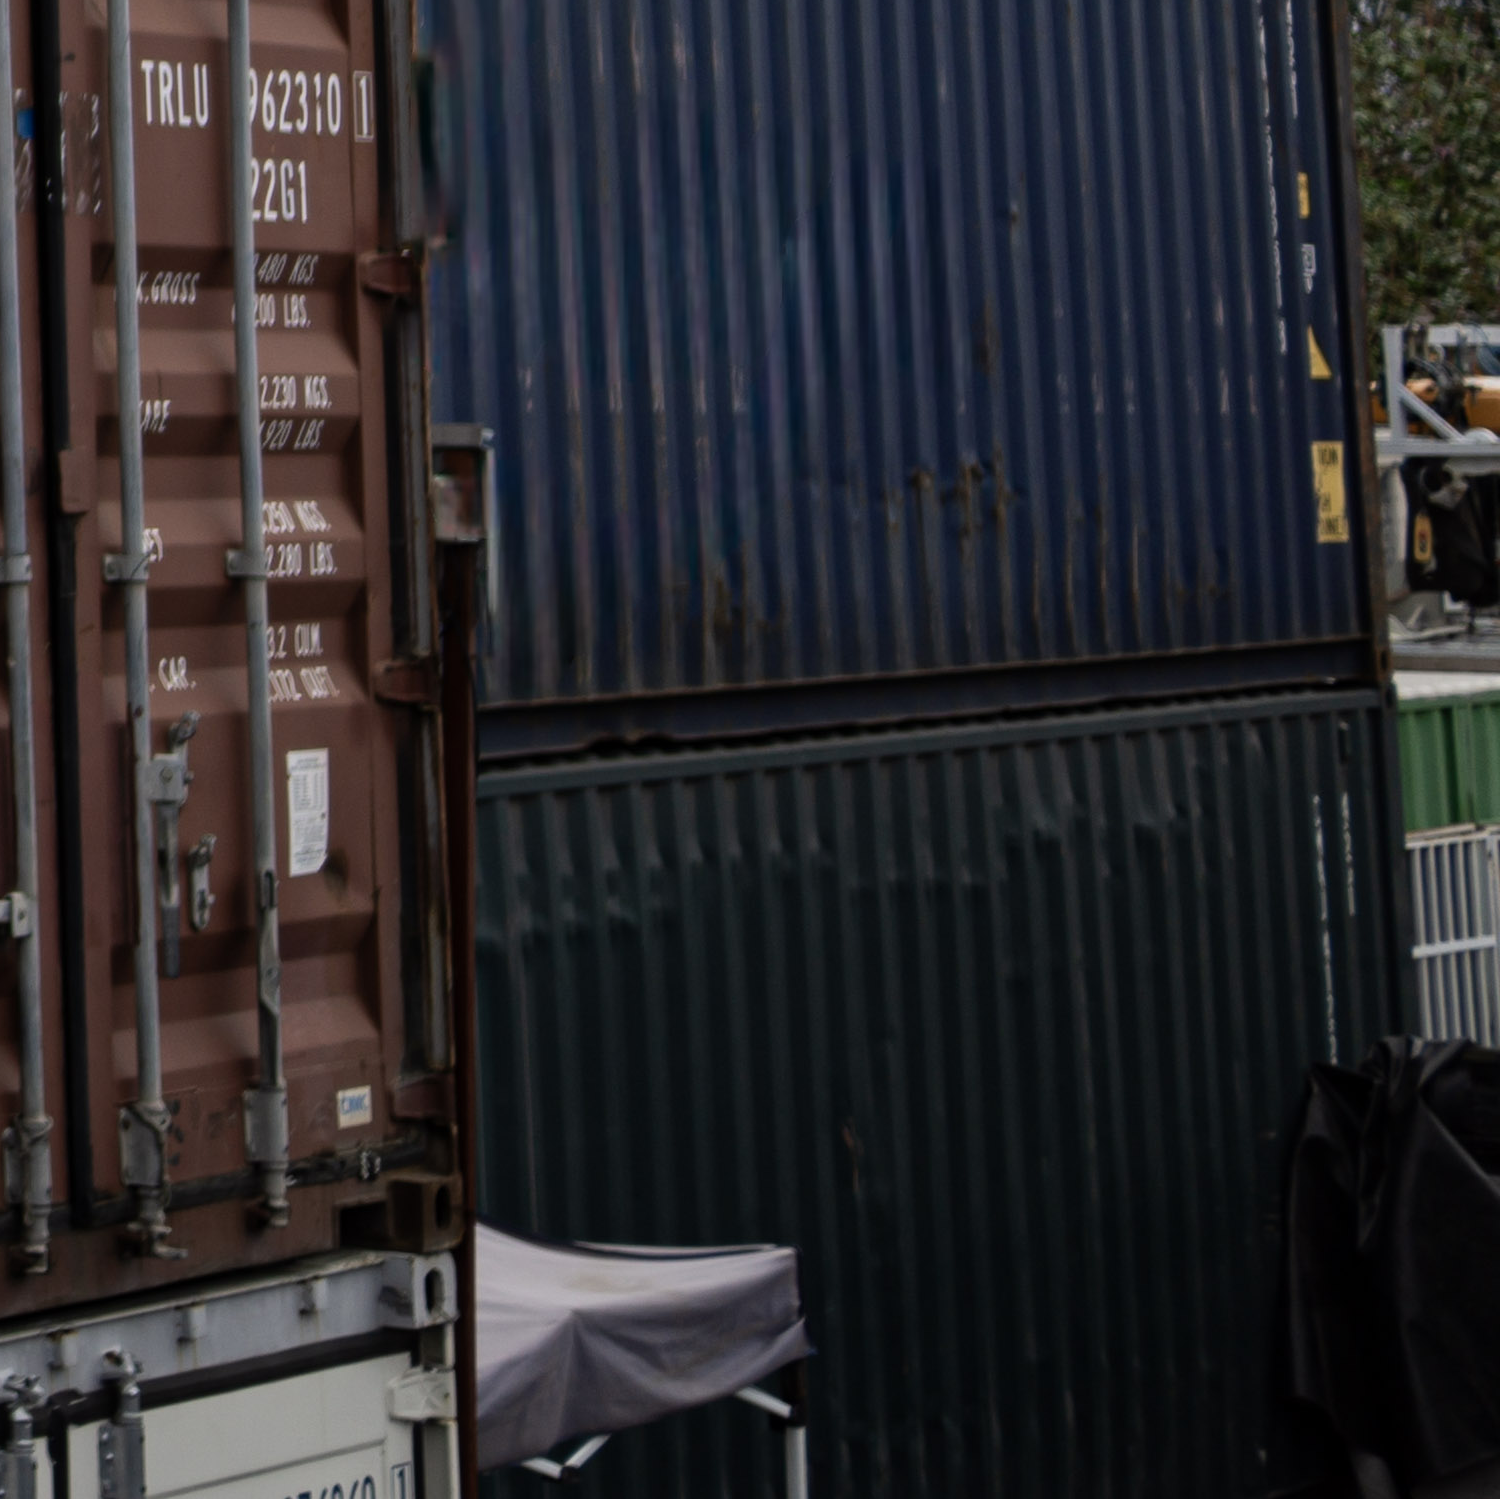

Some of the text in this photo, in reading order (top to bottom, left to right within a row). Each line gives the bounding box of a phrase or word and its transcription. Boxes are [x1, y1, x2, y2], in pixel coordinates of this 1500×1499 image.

[141, 60, 209, 128] TRLU
[135, 271, 200, 306] X.GROSS
[140, 399, 171, 434] ARE
